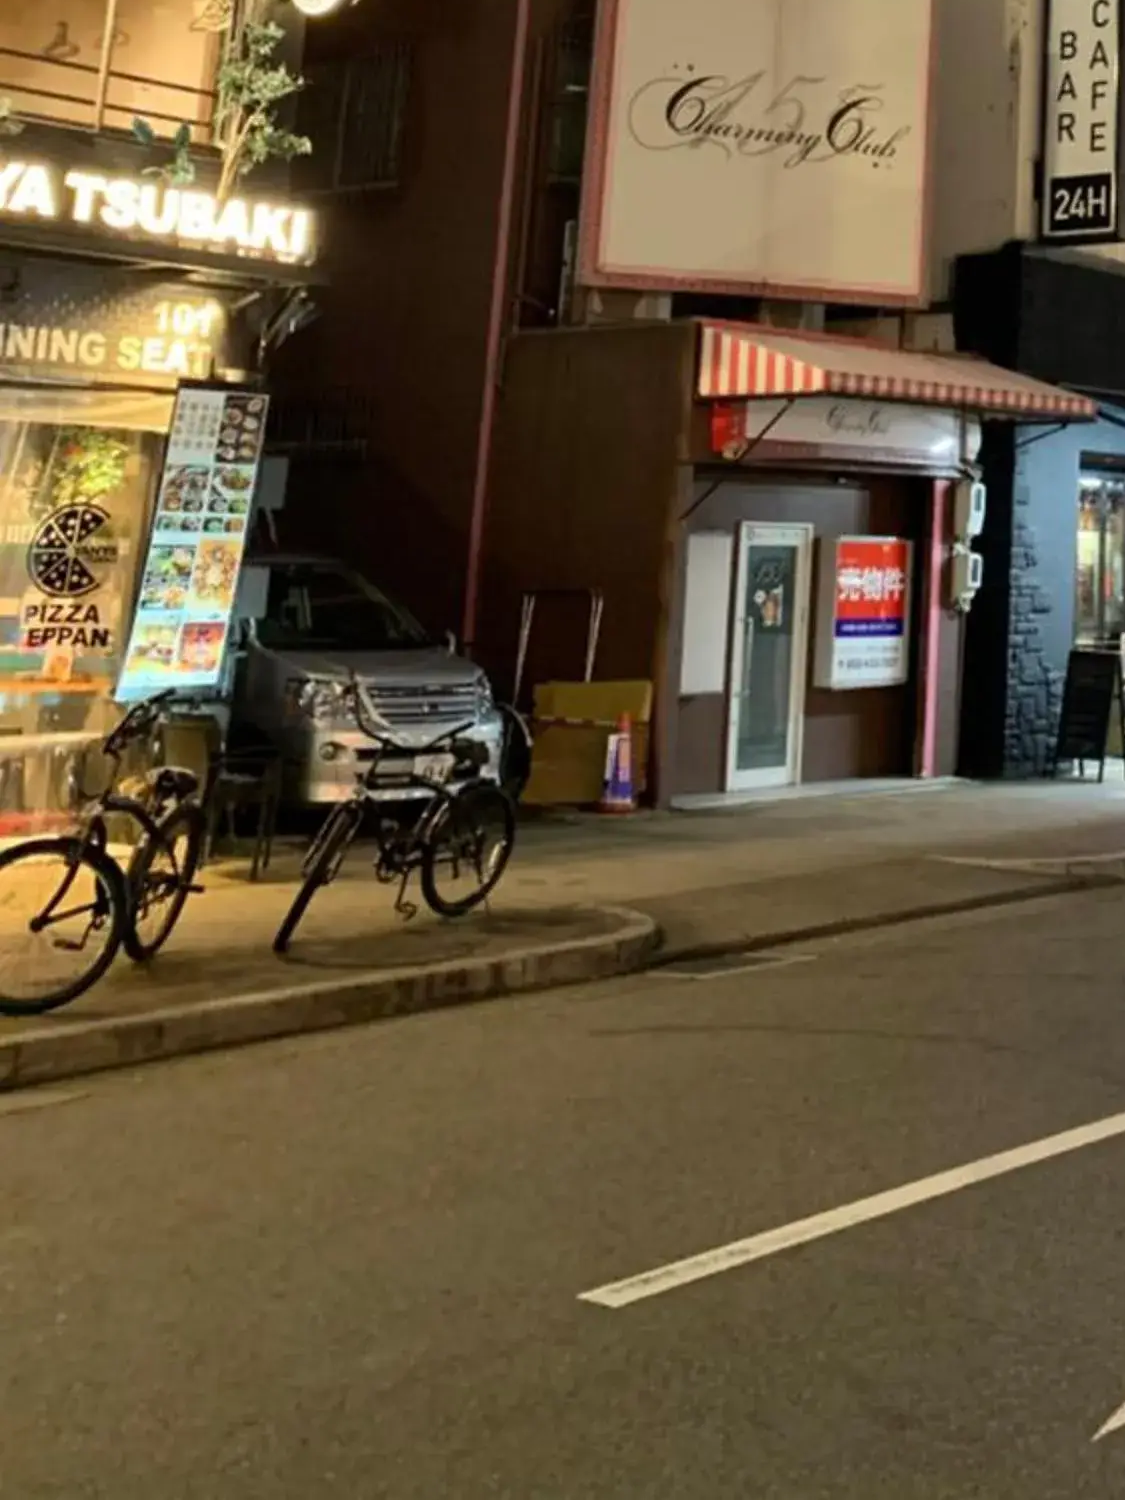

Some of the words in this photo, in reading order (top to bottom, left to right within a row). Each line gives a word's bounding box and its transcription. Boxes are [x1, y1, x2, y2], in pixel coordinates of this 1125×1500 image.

[1057, 30, 1078, 143] BAR
[665, 75, 823, 169] Charming
[825, 97, 912, 159] Club
[64, 171, 312, 257] TSUBAKI
[1054, 185, 1107, 220] 24H
[154, 301, 220, 338] 101
[116, 337, 212, 378] SEAT
[25, 603, 99, 624] PIZZA
[27, 627, 109, 648] EPPAN
